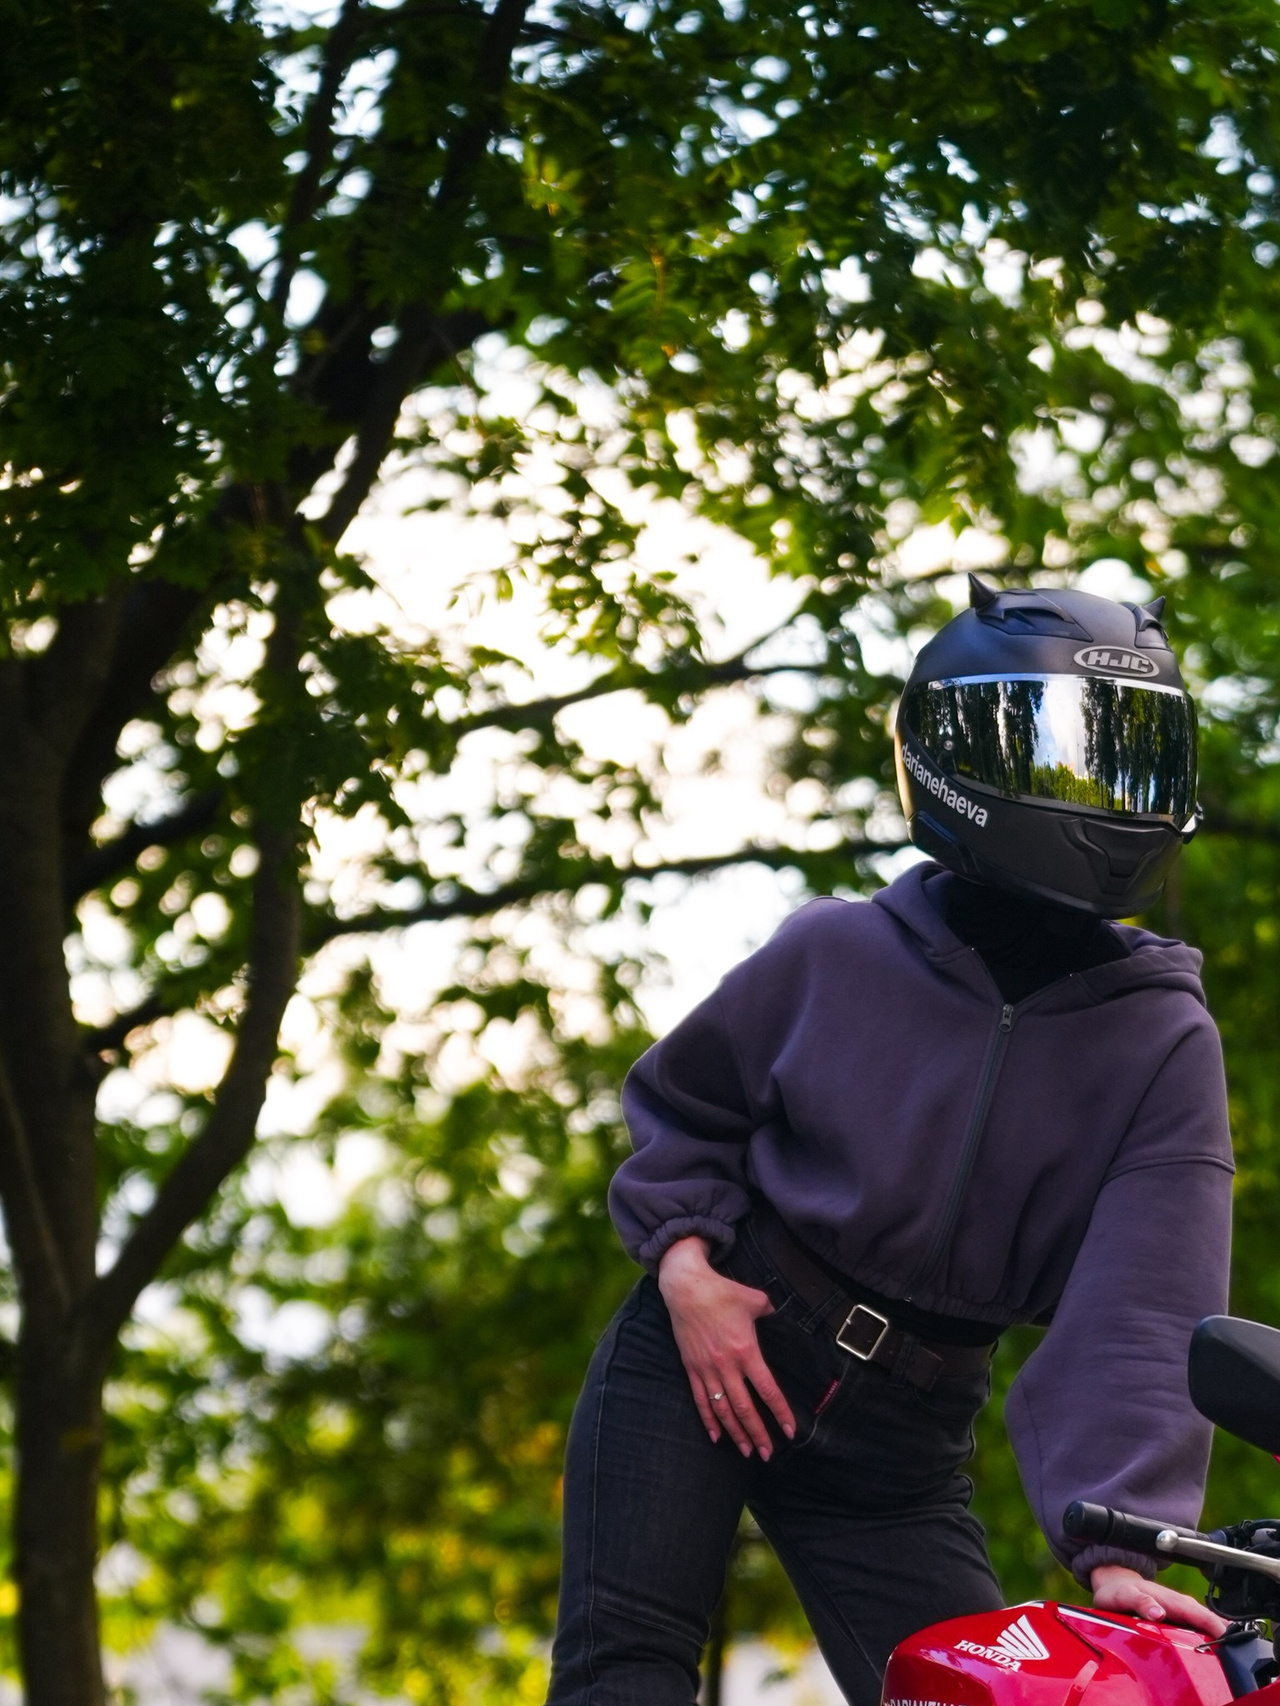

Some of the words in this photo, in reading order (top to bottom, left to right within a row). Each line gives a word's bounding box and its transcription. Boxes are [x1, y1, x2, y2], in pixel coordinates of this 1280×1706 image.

[1087, 651, 1151, 673] HJC
[901, 743, 988, 828] darianehaeva
[954, 1639, 1022, 1672] HONDA
